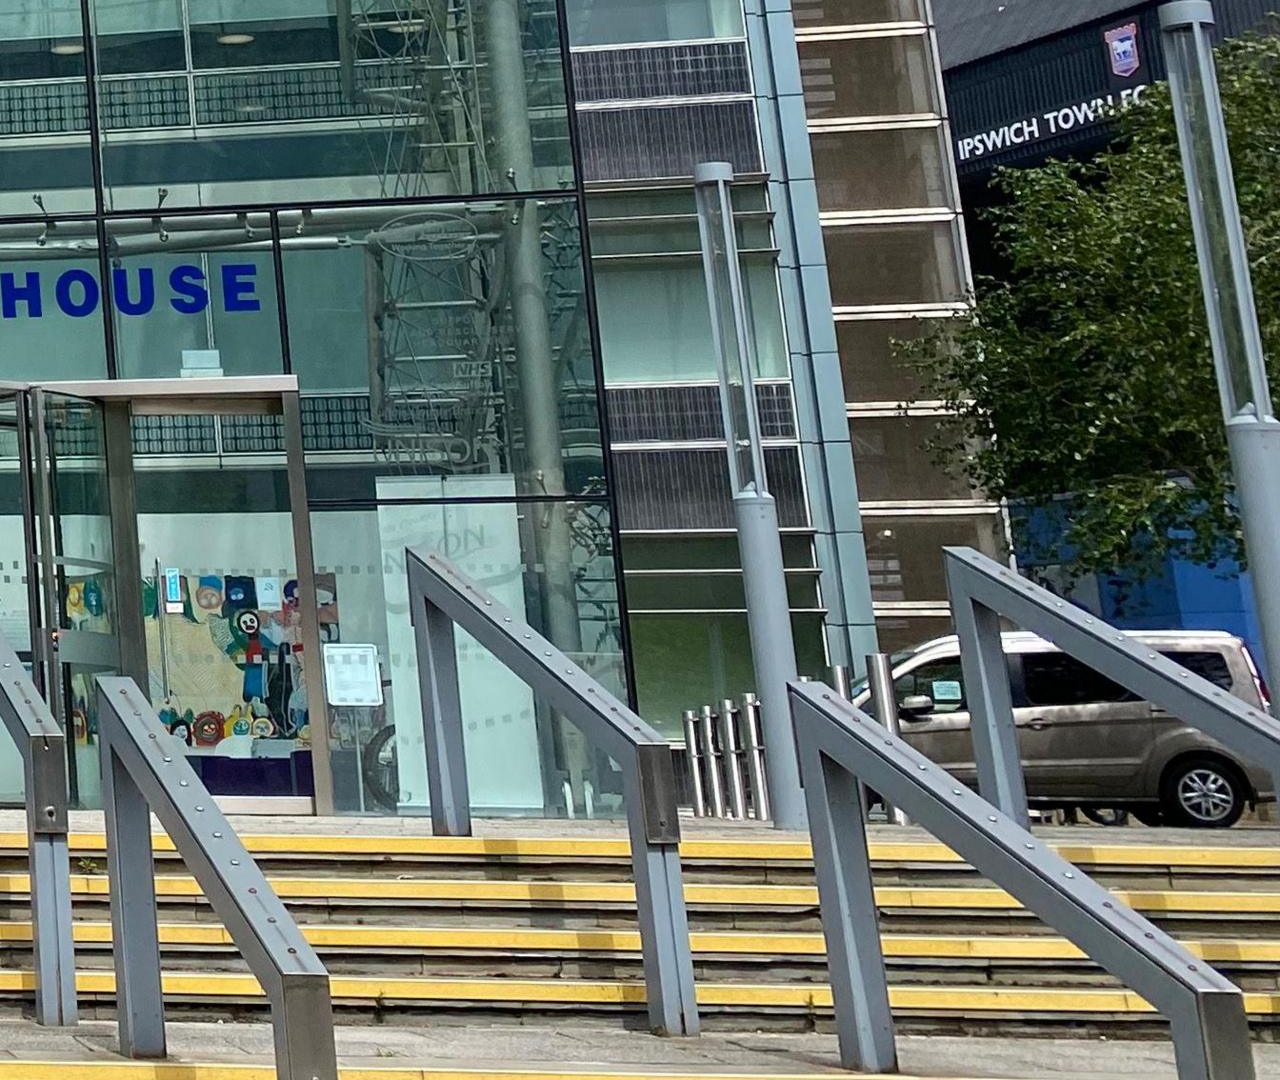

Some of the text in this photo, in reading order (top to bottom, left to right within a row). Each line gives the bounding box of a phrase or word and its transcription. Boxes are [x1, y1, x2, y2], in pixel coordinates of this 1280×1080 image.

[957, 118, 1040, 161] IPSWICH
[1043, 94, 1115, 134] TOWN
[0, 263, 261, 319] HOUSE
[454, 362, 489, 376] NHS
